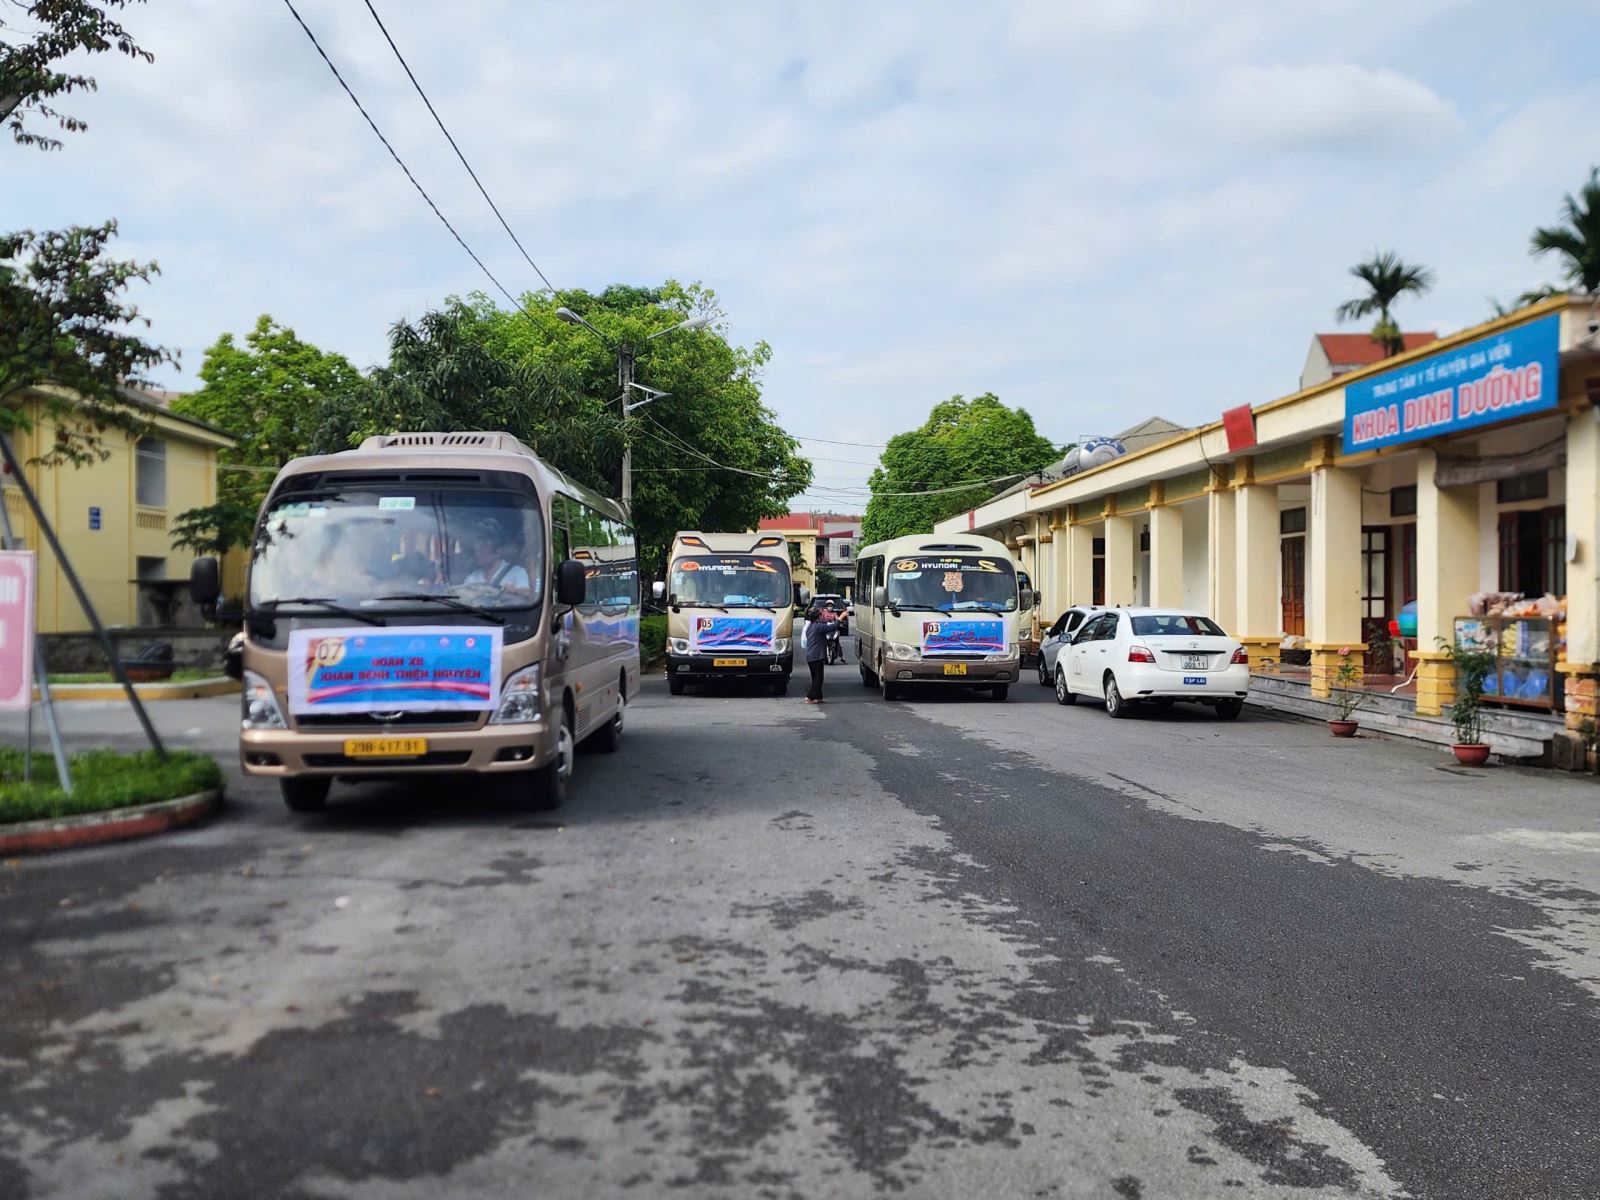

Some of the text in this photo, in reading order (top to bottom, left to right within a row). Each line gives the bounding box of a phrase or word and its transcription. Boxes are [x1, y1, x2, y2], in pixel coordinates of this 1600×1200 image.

[1373, 384, 1397, 398] TRUNG
[1352, 361, 1543, 445] KHOA DINH DƯỠNG
[701, 620, 712, 628] 05
[928, 624, 940, 633] 03
[318, 643, 343, 660] 07
[409, 656, 424, 666] XE
